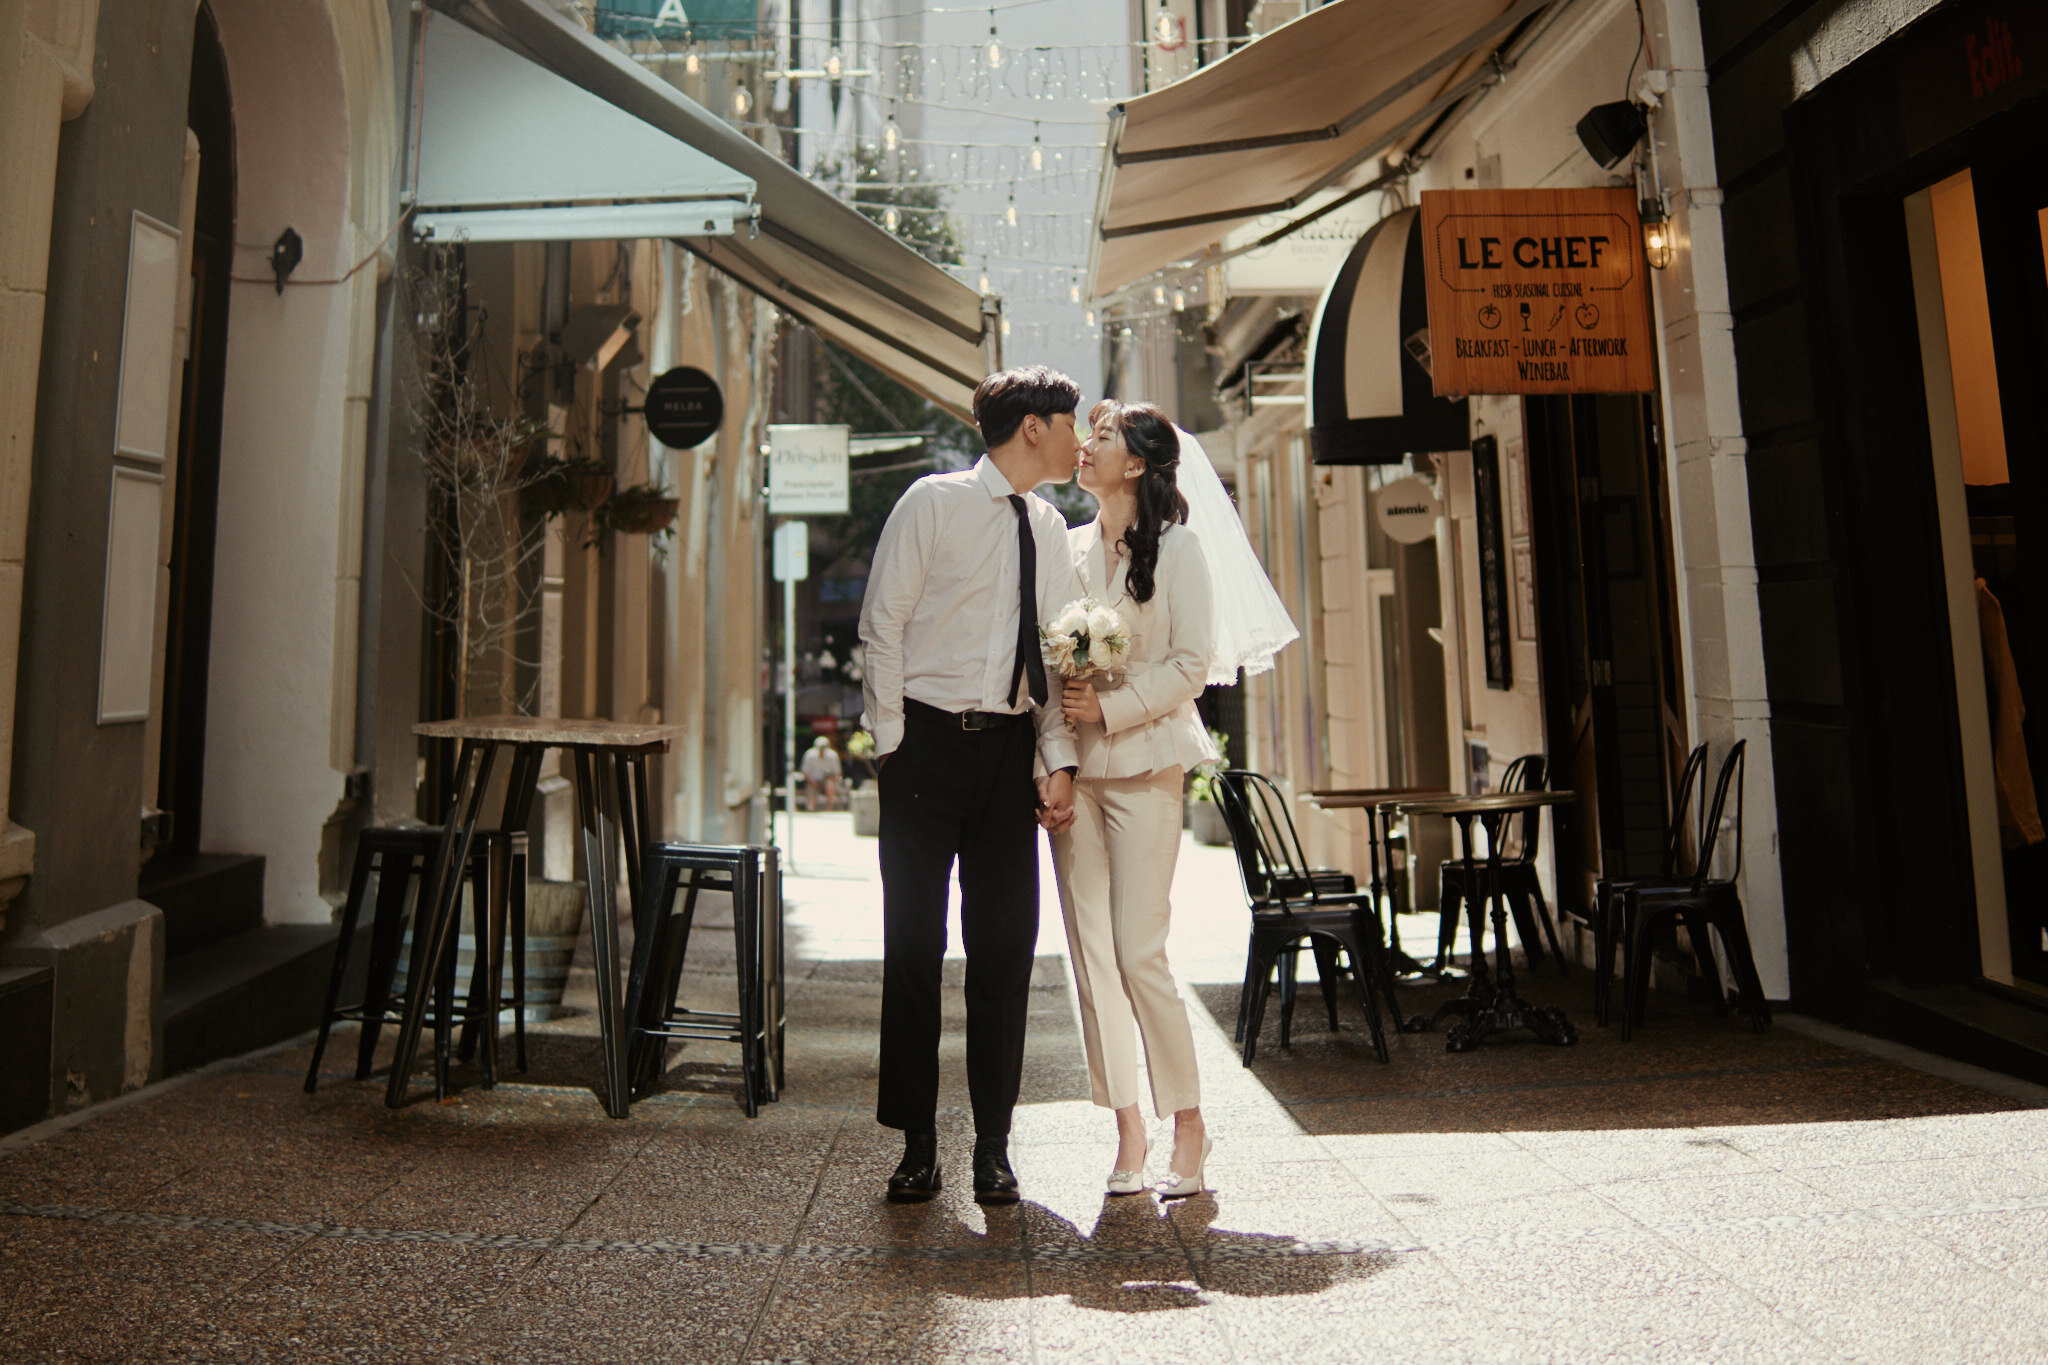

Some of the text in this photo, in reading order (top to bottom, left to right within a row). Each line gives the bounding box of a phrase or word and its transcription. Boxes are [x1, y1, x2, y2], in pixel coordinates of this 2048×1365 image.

[653, 0, 689, 28] A
[1457, 236, 1611, 269] LE CHEF
[1493, 282, 1583, 298] FRESH SEASONAL CUISINE
[1456, 337, 1510, 358] BREAKFAST
[1522, 337, 1557, 357] LUNCH
[1569, 336, 1628, 356] AFTERWORK
[1517, 360, 1570, 381] WINEBAR
[1387, 503, 1429, 516] atomic
